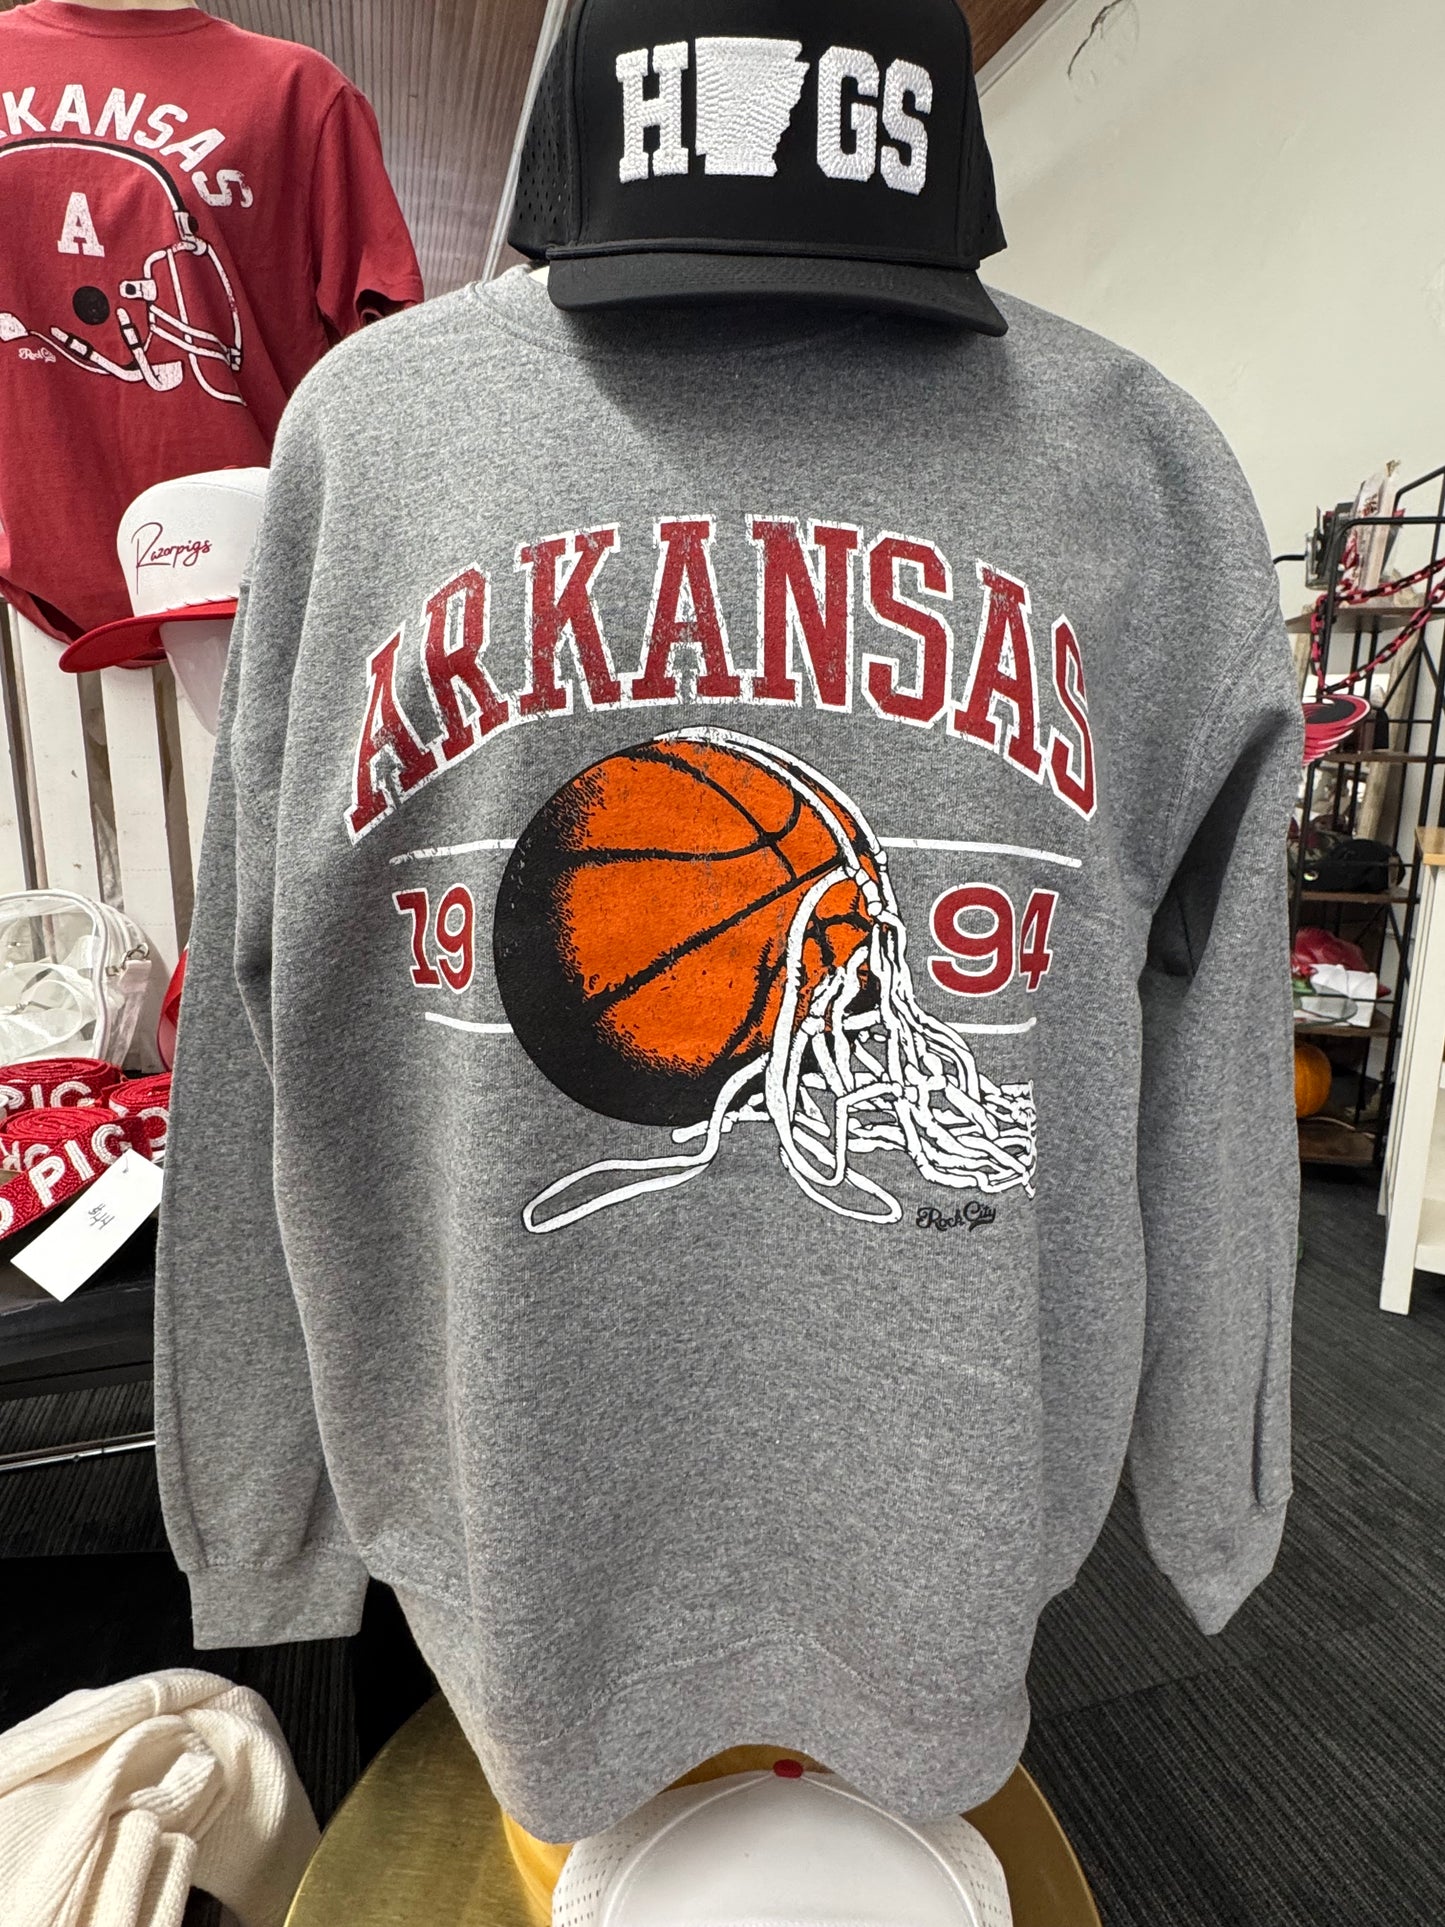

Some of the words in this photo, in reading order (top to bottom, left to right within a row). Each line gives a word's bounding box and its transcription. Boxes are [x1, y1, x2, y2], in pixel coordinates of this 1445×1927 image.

[0, 84, 254, 208] KANSAS
[615, 37, 933, 195] HGS
[57, 192, 105, 257] A
[131, 522, 212, 595] Razorpigs
[344, 513, 1098, 845] ARKANSAS
[392, 883, 475, 994] 19
[927, 882, 1059, 997] 94
[0, 1081, 96, 1110] PIG
[28, 1124, 132, 1208] PIG
[916, 1207, 965, 1231] Rock
[963, 1201, 996, 1232] City
